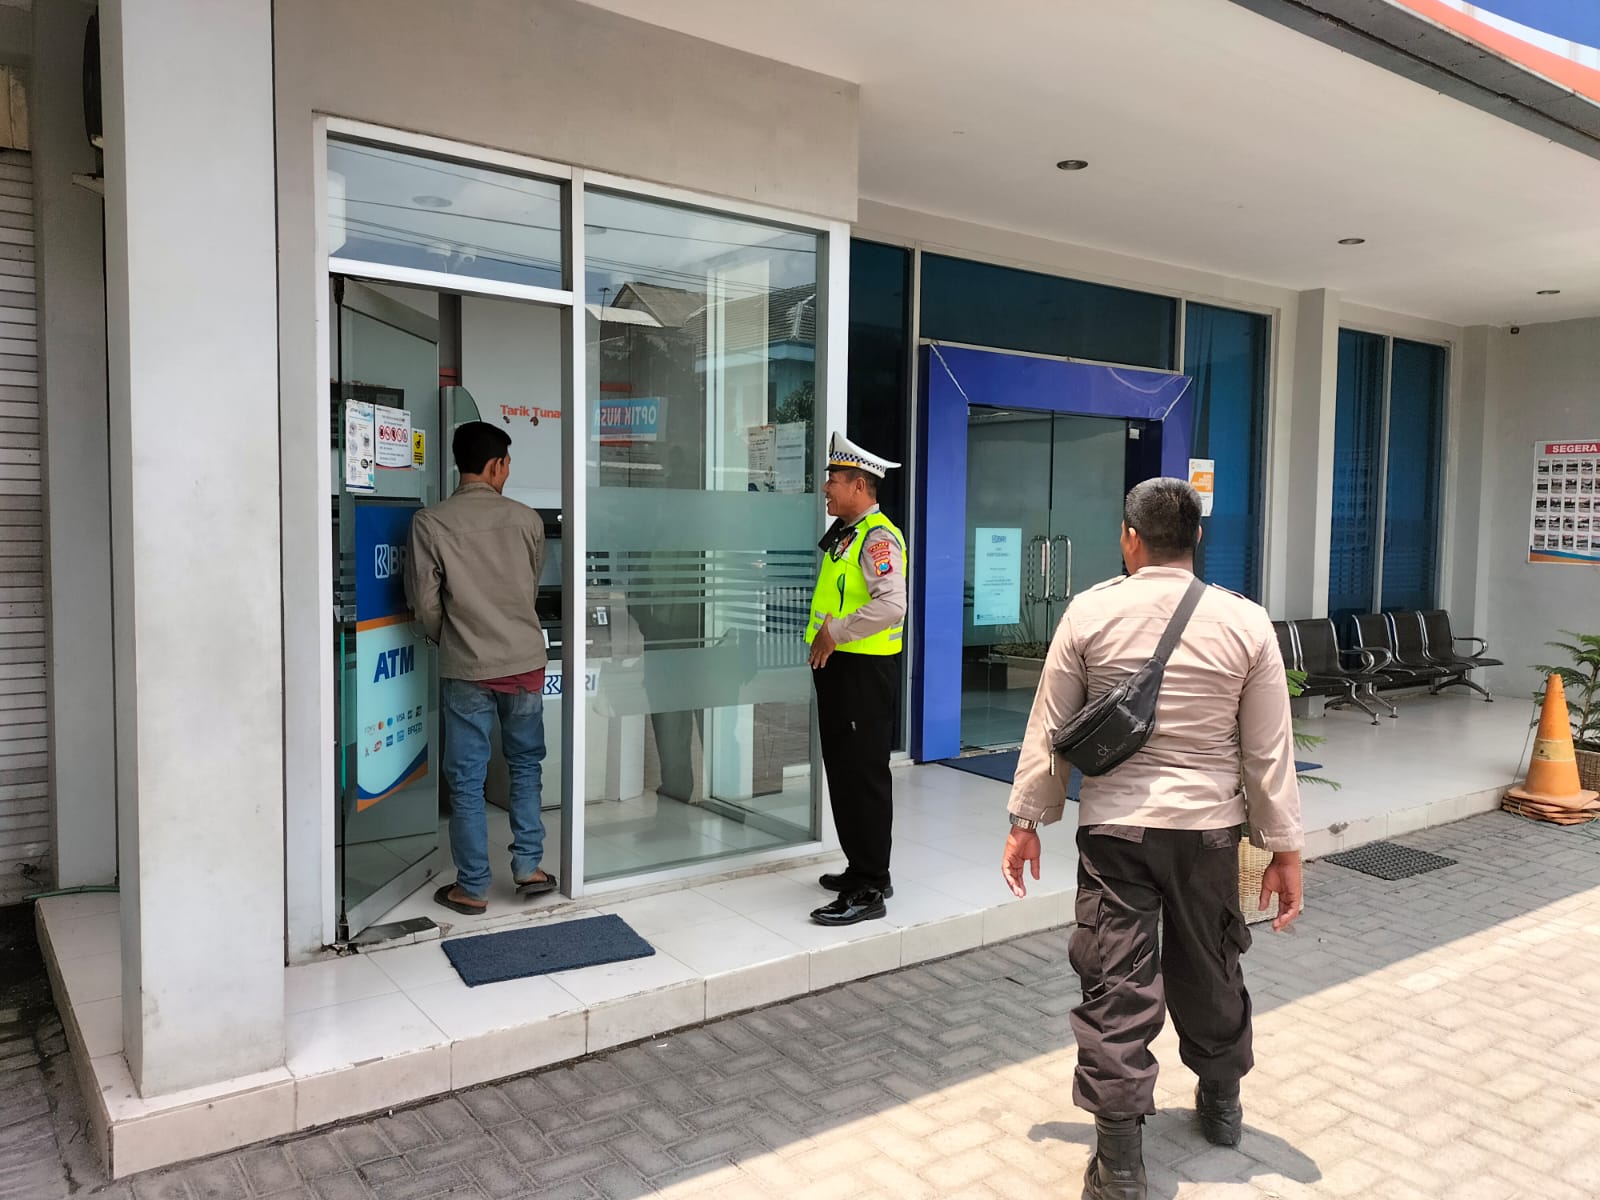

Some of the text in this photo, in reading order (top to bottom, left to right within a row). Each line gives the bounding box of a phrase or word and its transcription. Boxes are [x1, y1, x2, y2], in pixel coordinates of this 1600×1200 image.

[500, 404, 530, 417] Tarik
[1552, 444, 1598, 453] SEGERA
[373, 645, 414, 683] ATM
